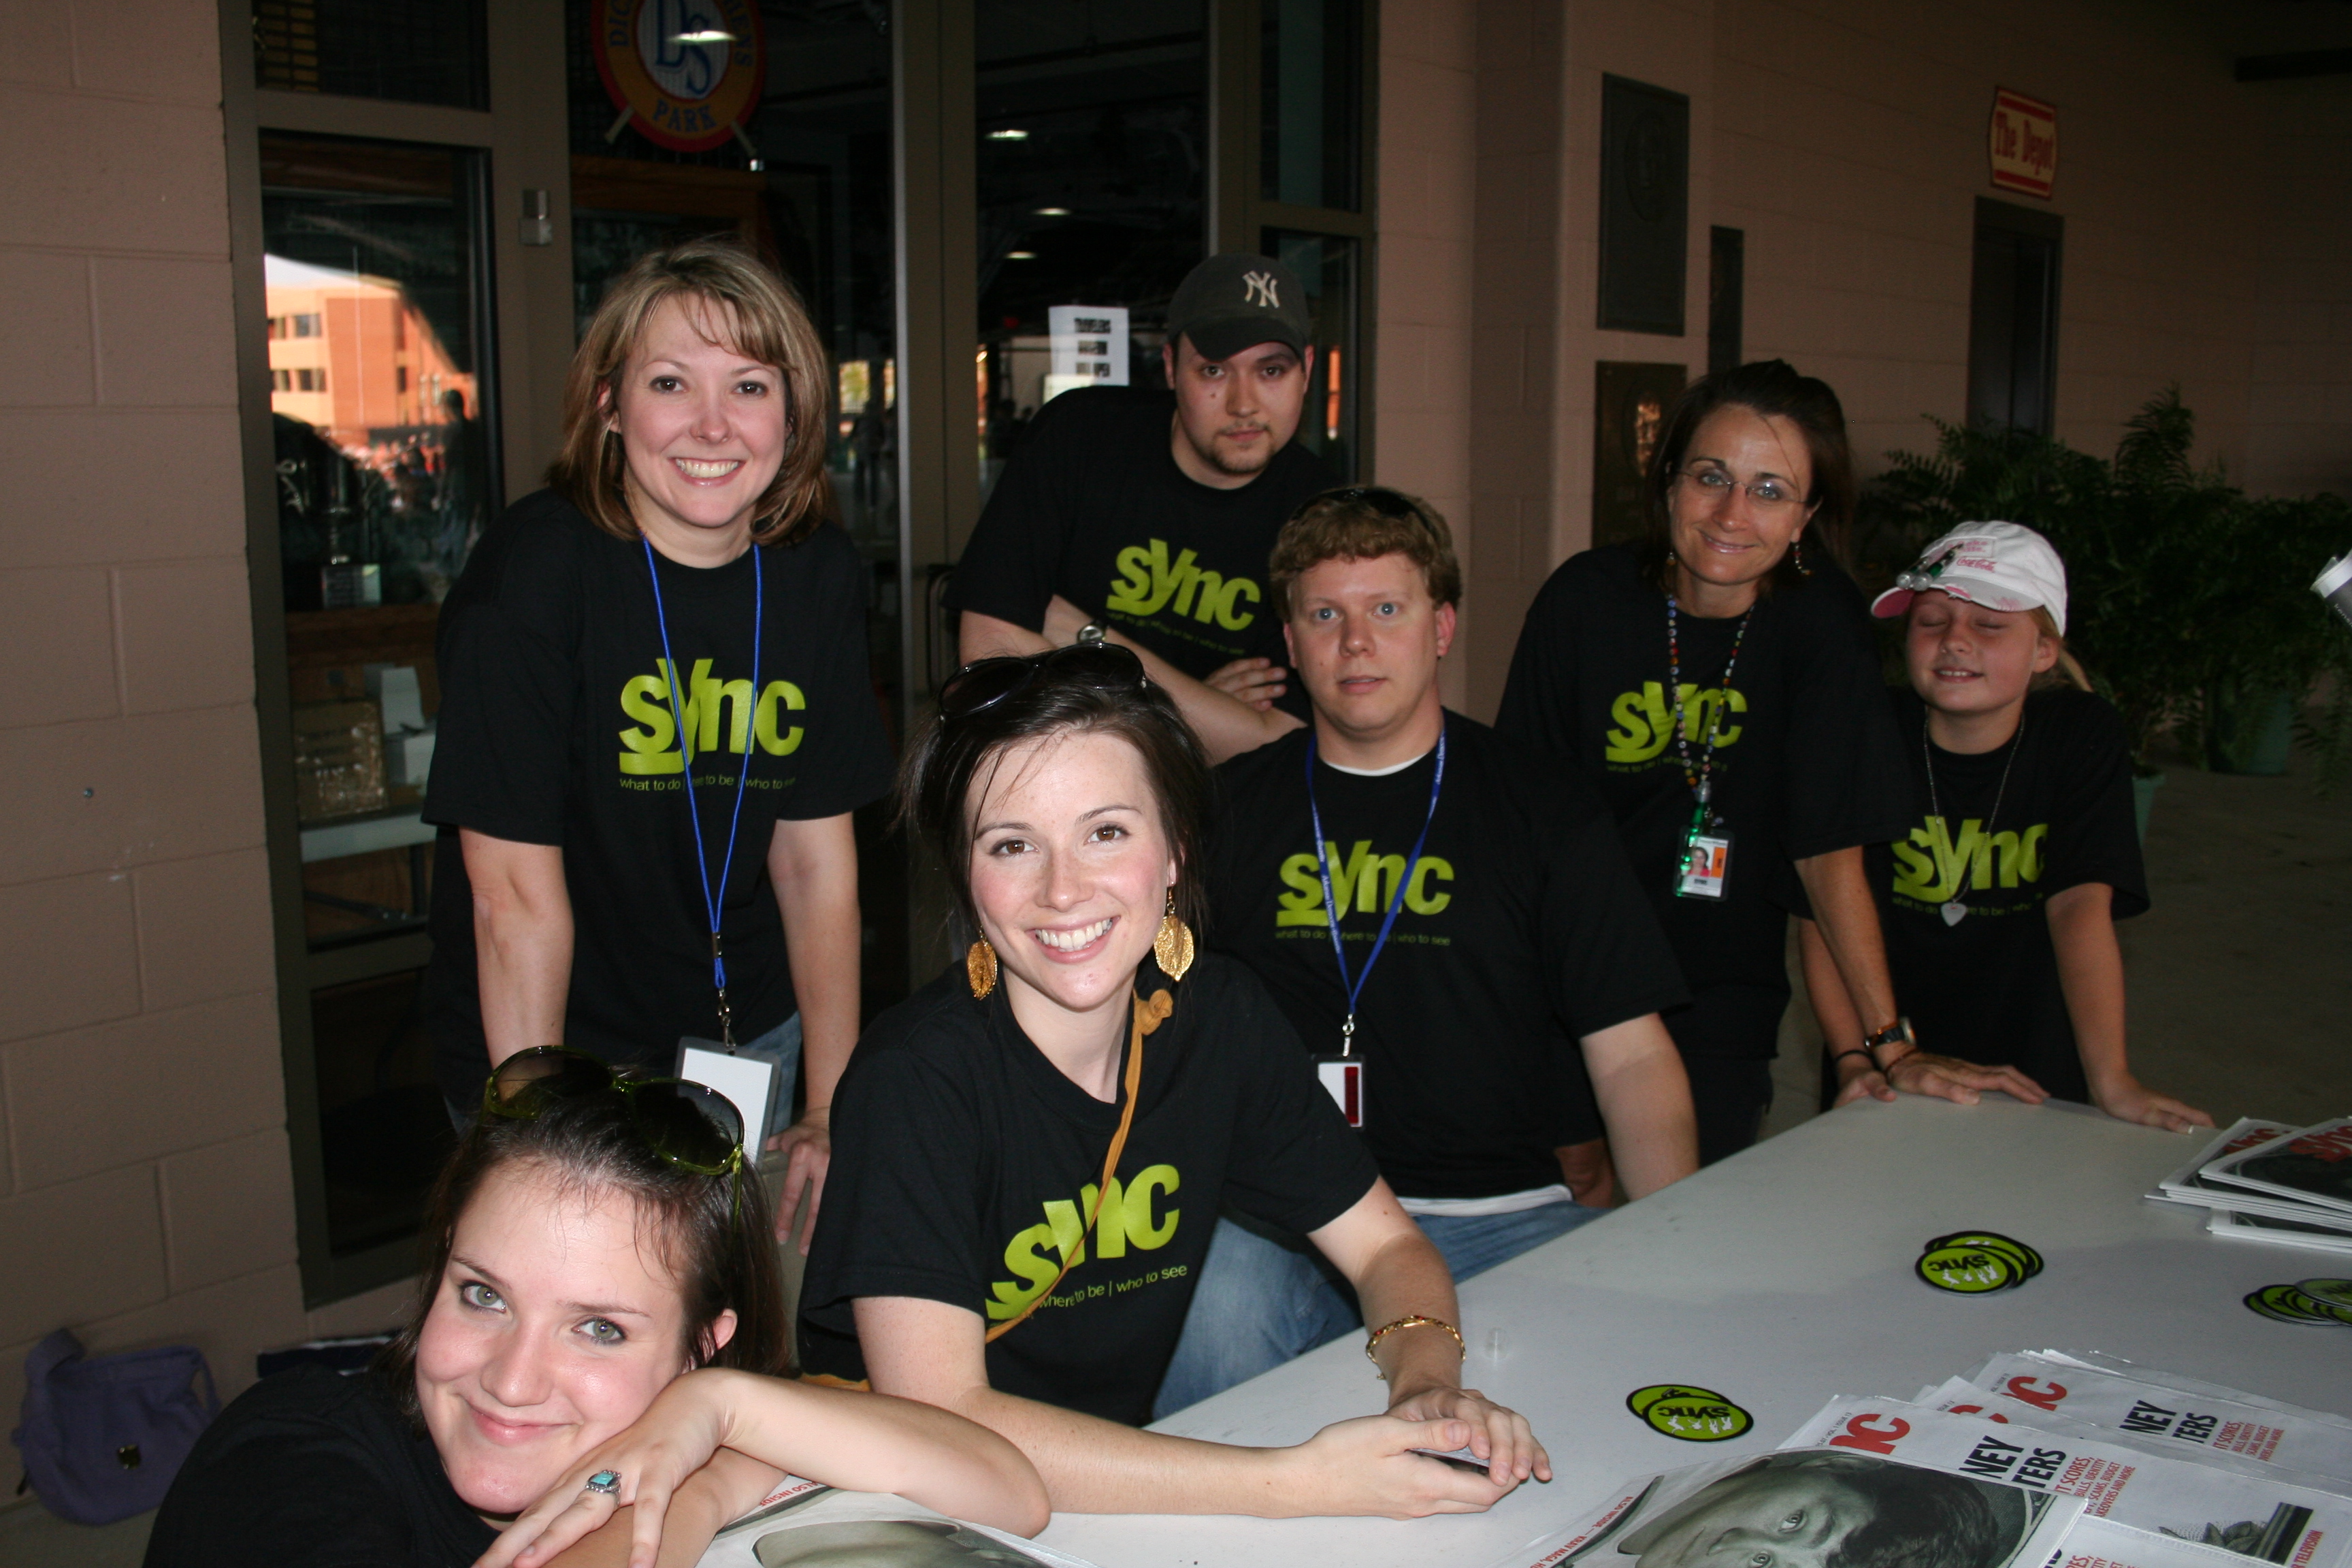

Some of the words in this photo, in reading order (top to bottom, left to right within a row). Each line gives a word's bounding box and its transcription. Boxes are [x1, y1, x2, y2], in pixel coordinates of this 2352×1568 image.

[653, 99, 717, 133] PARK
[1242, 271, 1279, 308] NY
[1106, 538, 1261, 631] sync
[619, 658, 806, 774] sync
[1605, 680, 1748, 763] sync
[619, 778, 650, 791] what
[653, 779, 666, 791] to
[668, 778, 681, 790] do
[704, 774, 715, 785] to
[719, 774, 734, 786] be
[745, 777, 769, 789] who
[772, 777, 783, 789] to
[1891, 815, 2048, 903] sync
[1276, 840, 1454, 927] sync
[1075, 1291, 1085, 1303] to
[1088, 1284, 1105, 1298] be
[1116, 1278, 1143, 1292] who
[1146, 1271, 1158, 1284] to
[1161, 1265, 1188, 1279] see
[1658, 1406, 1731, 1418] sync
[2119, 1399, 2177, 1435] NEY
[2171, 1412, 2219, 1443] TERS
[1958, 1435, 2025, 1480] NEY
[2011, 1448, 2066, 1488] TERS
[2060, 1456, 2093, 1486] SCORES,
[2073, 1480, 2093, 1497] BILLS,
[2085, 1458, 2107, 1484] IDENTITY
[2088, 1481, 2107, 1501] SCAMS,
[2100, 1461, 2121, 1482] BUDGET
[2110, 1477, 2126, 1494] AND
[2118, 1465, 2136, 1482] MORE
[1592, 1510, 1619, 1527] INSIDE
[1614, 1496, 1633, 1510] ALSO
[1564, 1535, 1587, 1550] KRAV
[2293, 1530, 2323, 1564] TELEVISION
